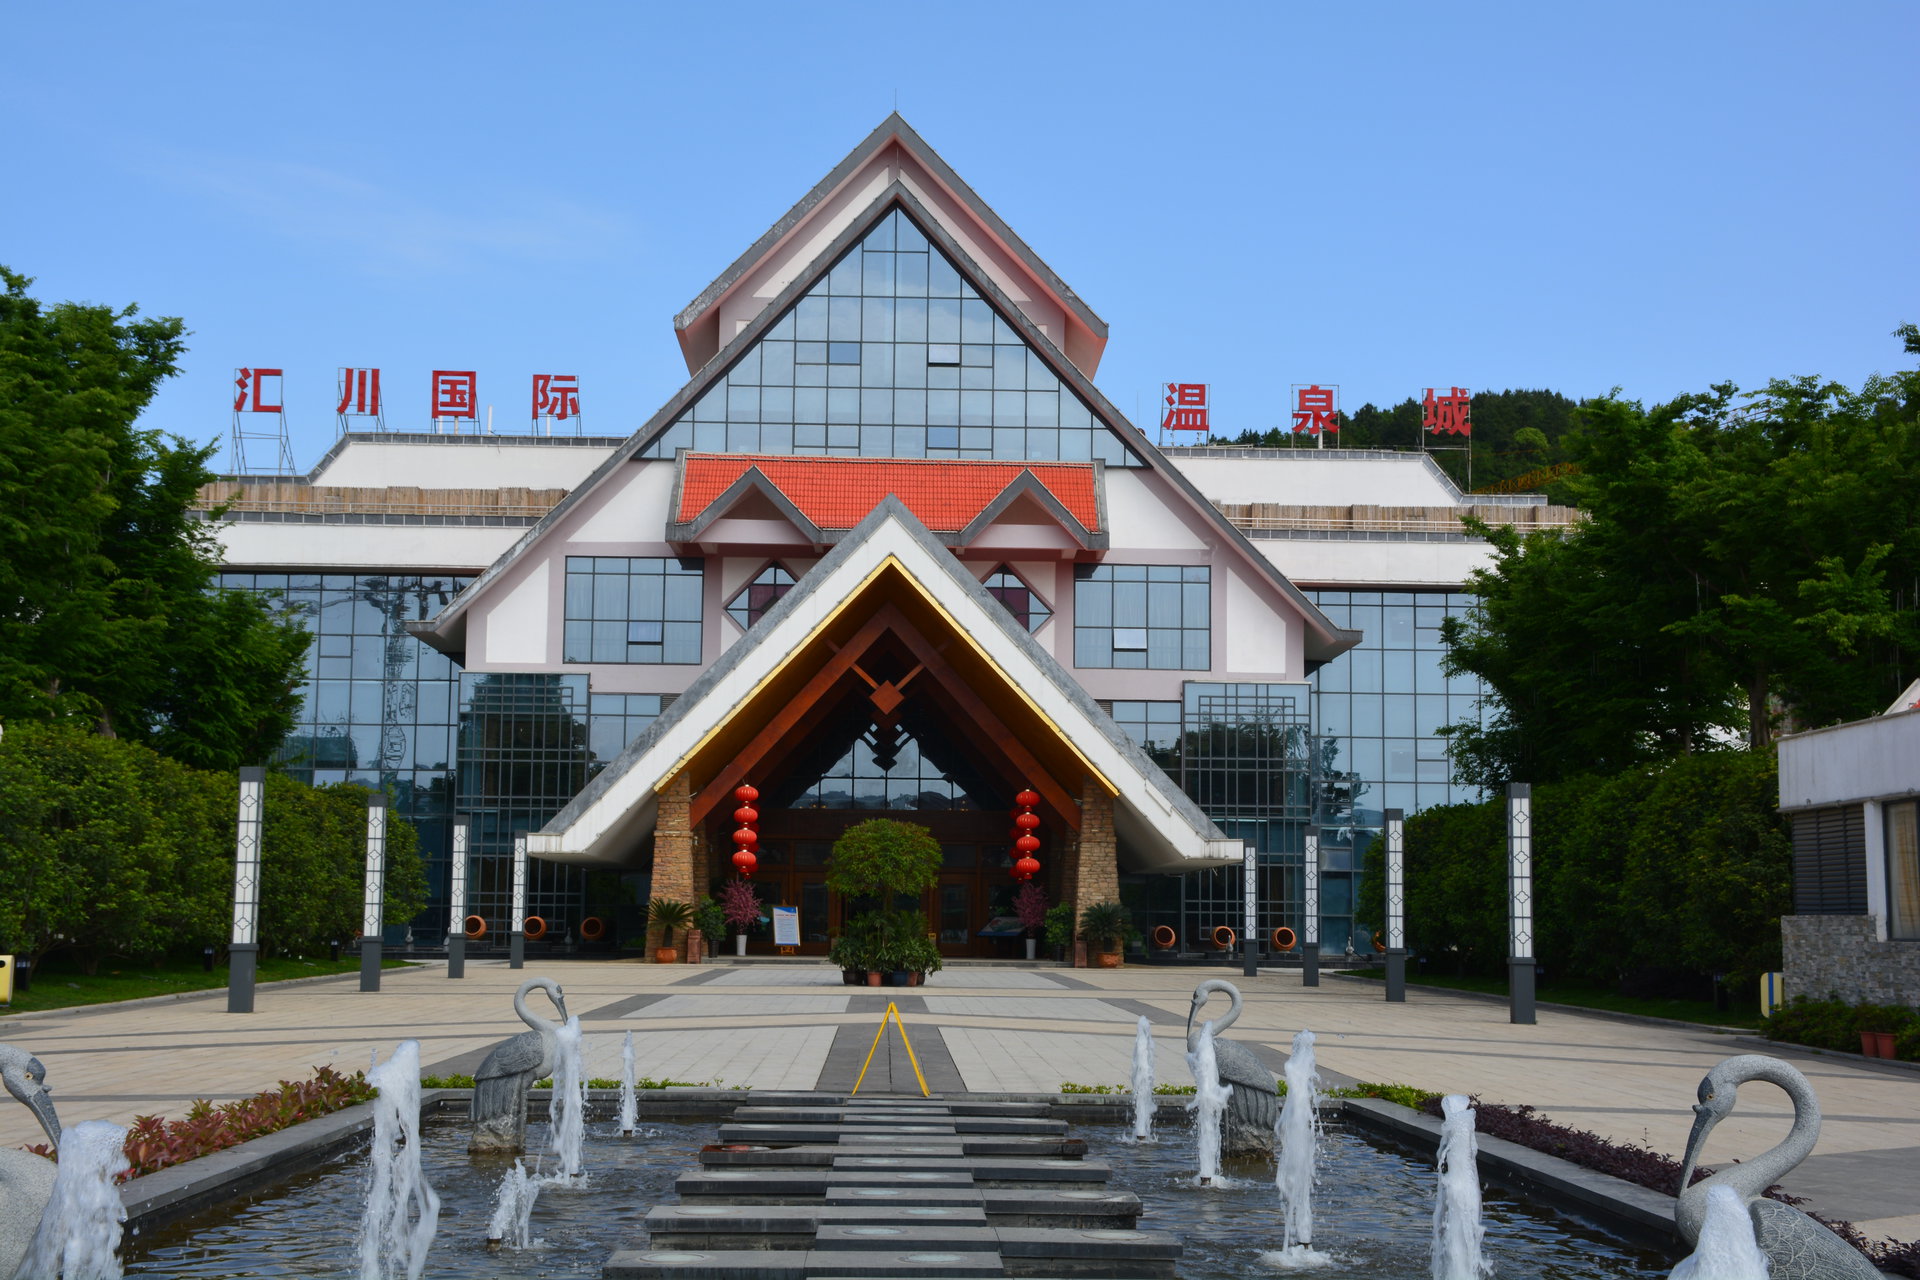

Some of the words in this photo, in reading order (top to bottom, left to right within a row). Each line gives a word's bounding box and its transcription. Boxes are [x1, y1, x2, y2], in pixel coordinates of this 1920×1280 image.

[234, 367, 579, 420] 汇川国际
[1162, 383, 1472, 436] 温泉城
